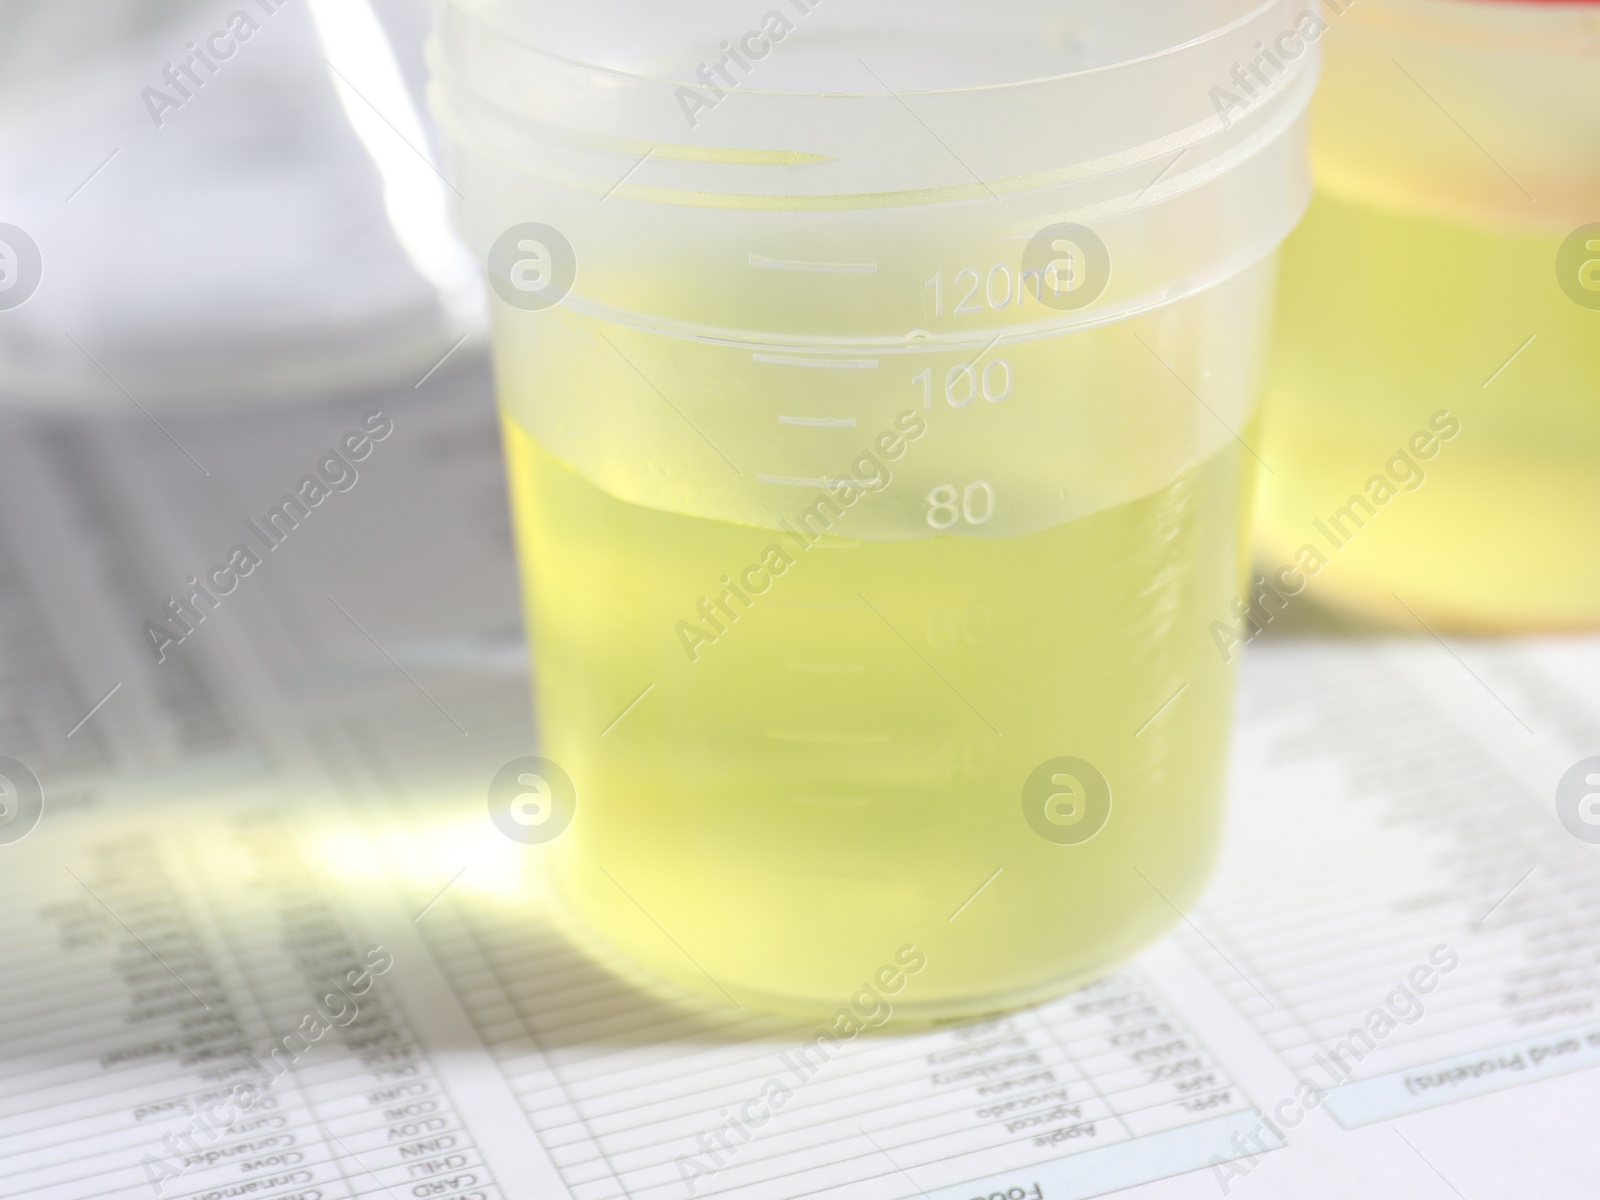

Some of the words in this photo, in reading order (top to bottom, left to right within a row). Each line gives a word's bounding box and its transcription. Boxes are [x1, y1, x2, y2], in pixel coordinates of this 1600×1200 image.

[924, 248, 1074, 317] 120ml
[911, 356, 1014, 410] 100
[924, 480, 997, 531] 80
[977, 1070, 1056, 1098] Banana
[977, 1087, 1068, 1120] Avocado
[385, 1116, 447, 1141] CLOV
[1003, 1105, 1081, 1134] Apricot
[181, 1132, 296, 1169] Coriander
[398, 1134, 458, 1159] CINN
[1034, 1123, 1096, 1149] Apple
[238, 1150, 304, 1176] Clove
[192, 1170, 314, 1200] Cinnamon
[412, 1172, 478, 1198] CARD
